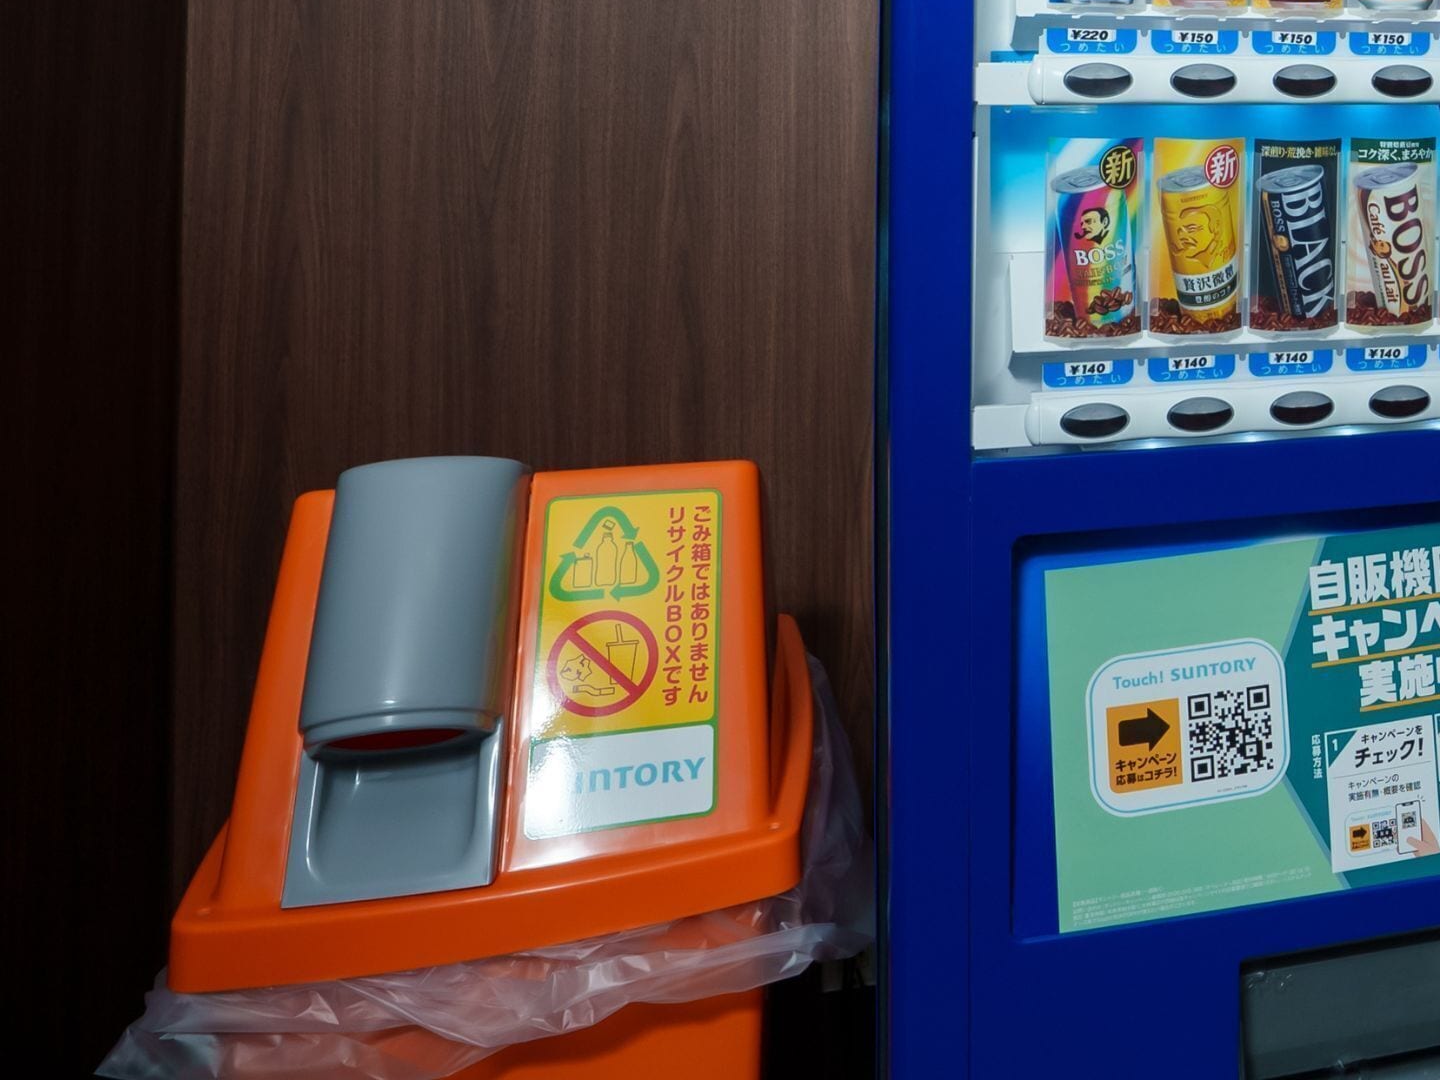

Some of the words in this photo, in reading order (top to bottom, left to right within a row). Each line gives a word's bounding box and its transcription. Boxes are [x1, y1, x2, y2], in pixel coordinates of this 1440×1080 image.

[1069, 28, 1109, 42] ¥220
[1178, 31, 1214, 44] ¥150
[1278, 32, 1313, 45] ¥150
[1370, 33, 1405, 45] ¥150
[1103, 150, 1134, 186] 新
[1208, 150, 1237, 185] 新
[1270, 199, 1286, 233] BOSS
[1367, 202, 1386, 238] Café
[1074, 238, 1126, 267] BOSS
[1281, 182, 1336, 318] BLACK
[1384, 184, 1430, 306] BOSS
[1172, 356, 1208, 370] ¥140
[1274, 351, 1309, 365] ¥140
[1368, 347, 1402, 360] ¥140
[1069, 362, 1107, 377] ¥140
[661, 505, 687, 707] リサイクルBOXです
[688, 504, 713, 705] ごみ箱ではありません
[1112, 669, 1165, 690] Touch!
[1170, 656, 1257, 683] SUNTORY
[1360, 724, 1424, 745] キャンペーンを
[1114, 750, 1178, 773] キャンペーン
[1311, 734, 1324, 779] 応募方法
[1354, 737, 1425, 769] チェック!
[572, 756, 707, 795] NTORY
[1115, 764, 1178, 788] 応募はコチラ!
[1347, 773, 1400, 790] キャンペーンの
